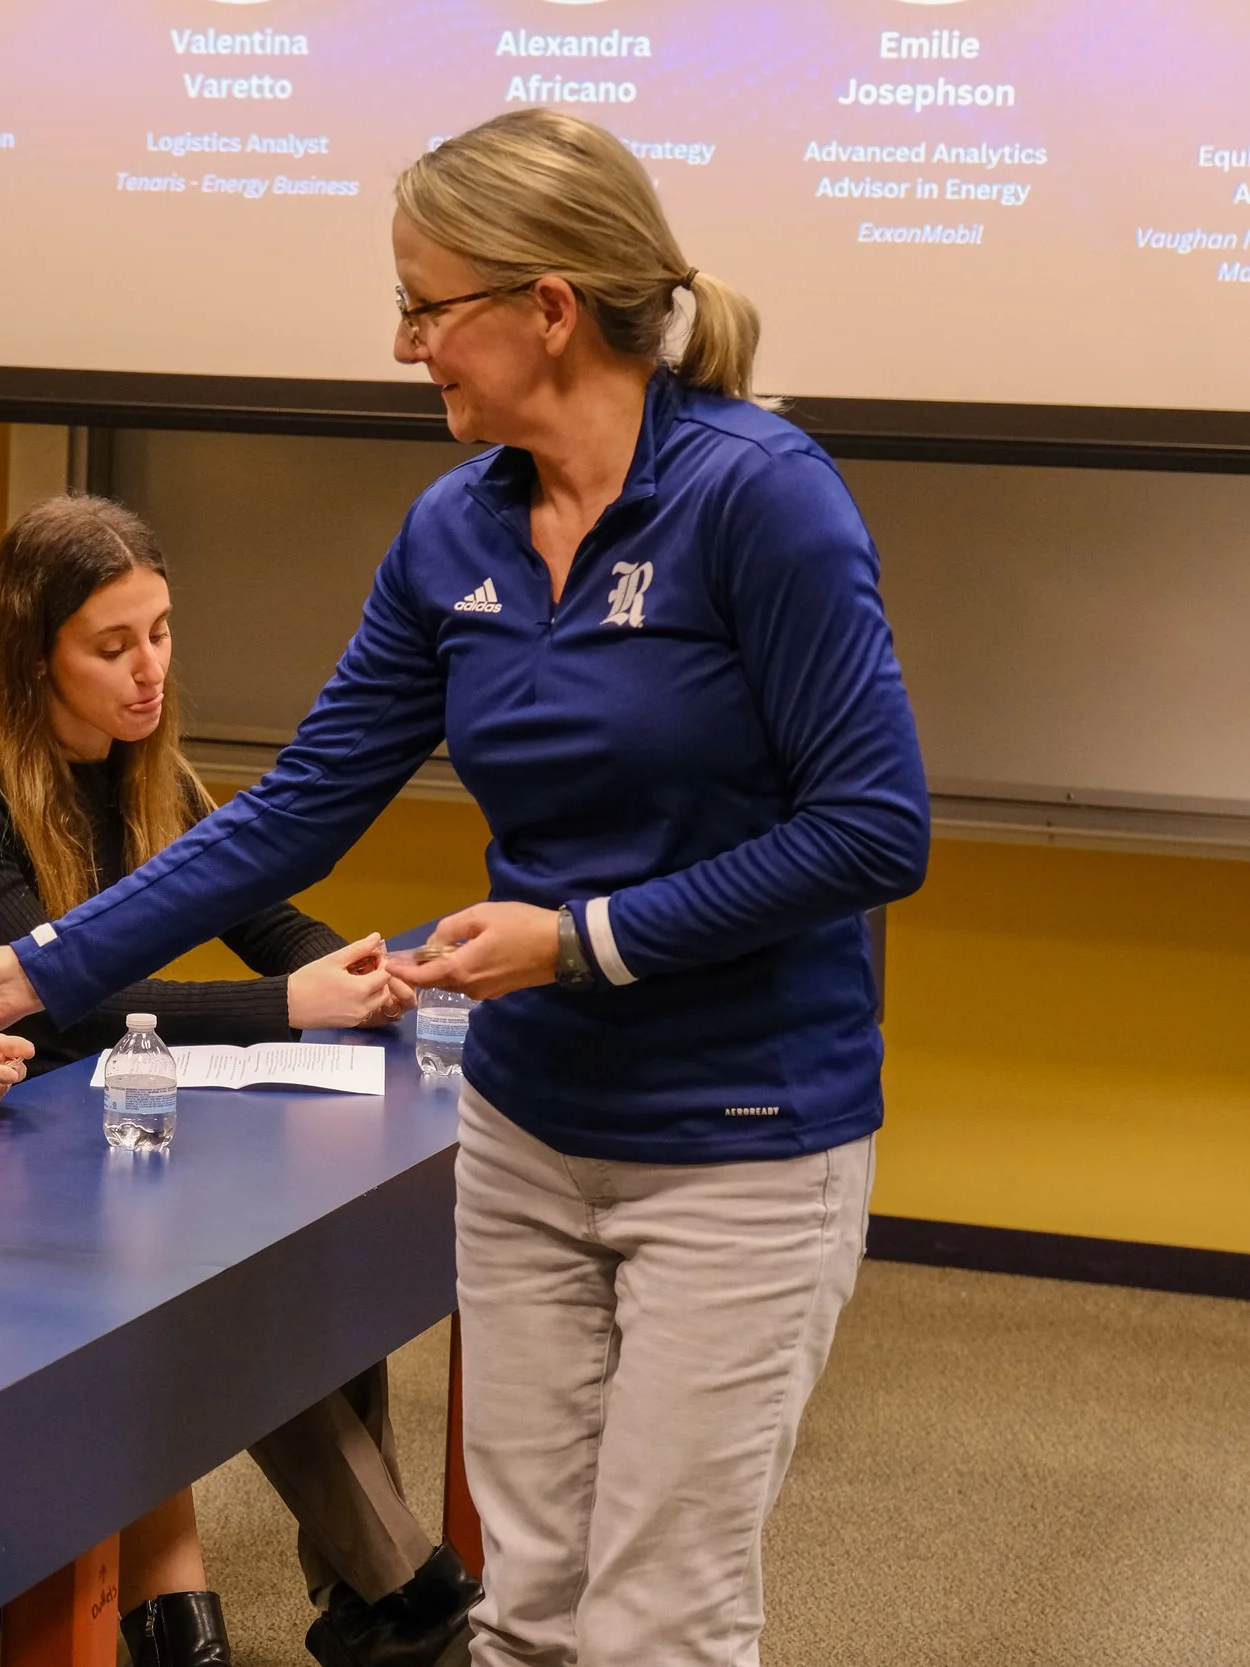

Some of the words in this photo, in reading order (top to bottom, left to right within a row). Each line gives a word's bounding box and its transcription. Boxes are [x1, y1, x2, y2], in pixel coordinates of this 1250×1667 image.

[170, 27, 309, 55] Valentina
[495, 29, 652, 57] Alexandra
[880, 30, 980, 59] Emilie
[183, 72, 293, 99] Varetto
[505, 75, 637, 103] Africano
[838, 77, 1015, 113] Josephson
[146, 132, 241, 156] Logistics
[246, 133, 329, 158] Analyst
[619, 137, 716, 165] trategy
[804, 141, 926, 163] Advanced
[931, 142, 1047, 169] Analytics
[115, 172, 185, 192] Tenaris
[202, 174, 269, 198] Energy
[273, 175, 360, 196] Business
[815, 177, 910, 199] Advisor
[916, 177, 938, 199] in
[945, 179, 1031, 206] Energy
[857, 222, 984, 244] ExxonMobil
[1136, 227, 1238, 254] Vaughan
[454, 600, 503, 613] adidas
[600, 561, 654, 628] R
[725, 1106, 780, 1117] AEROREADY
